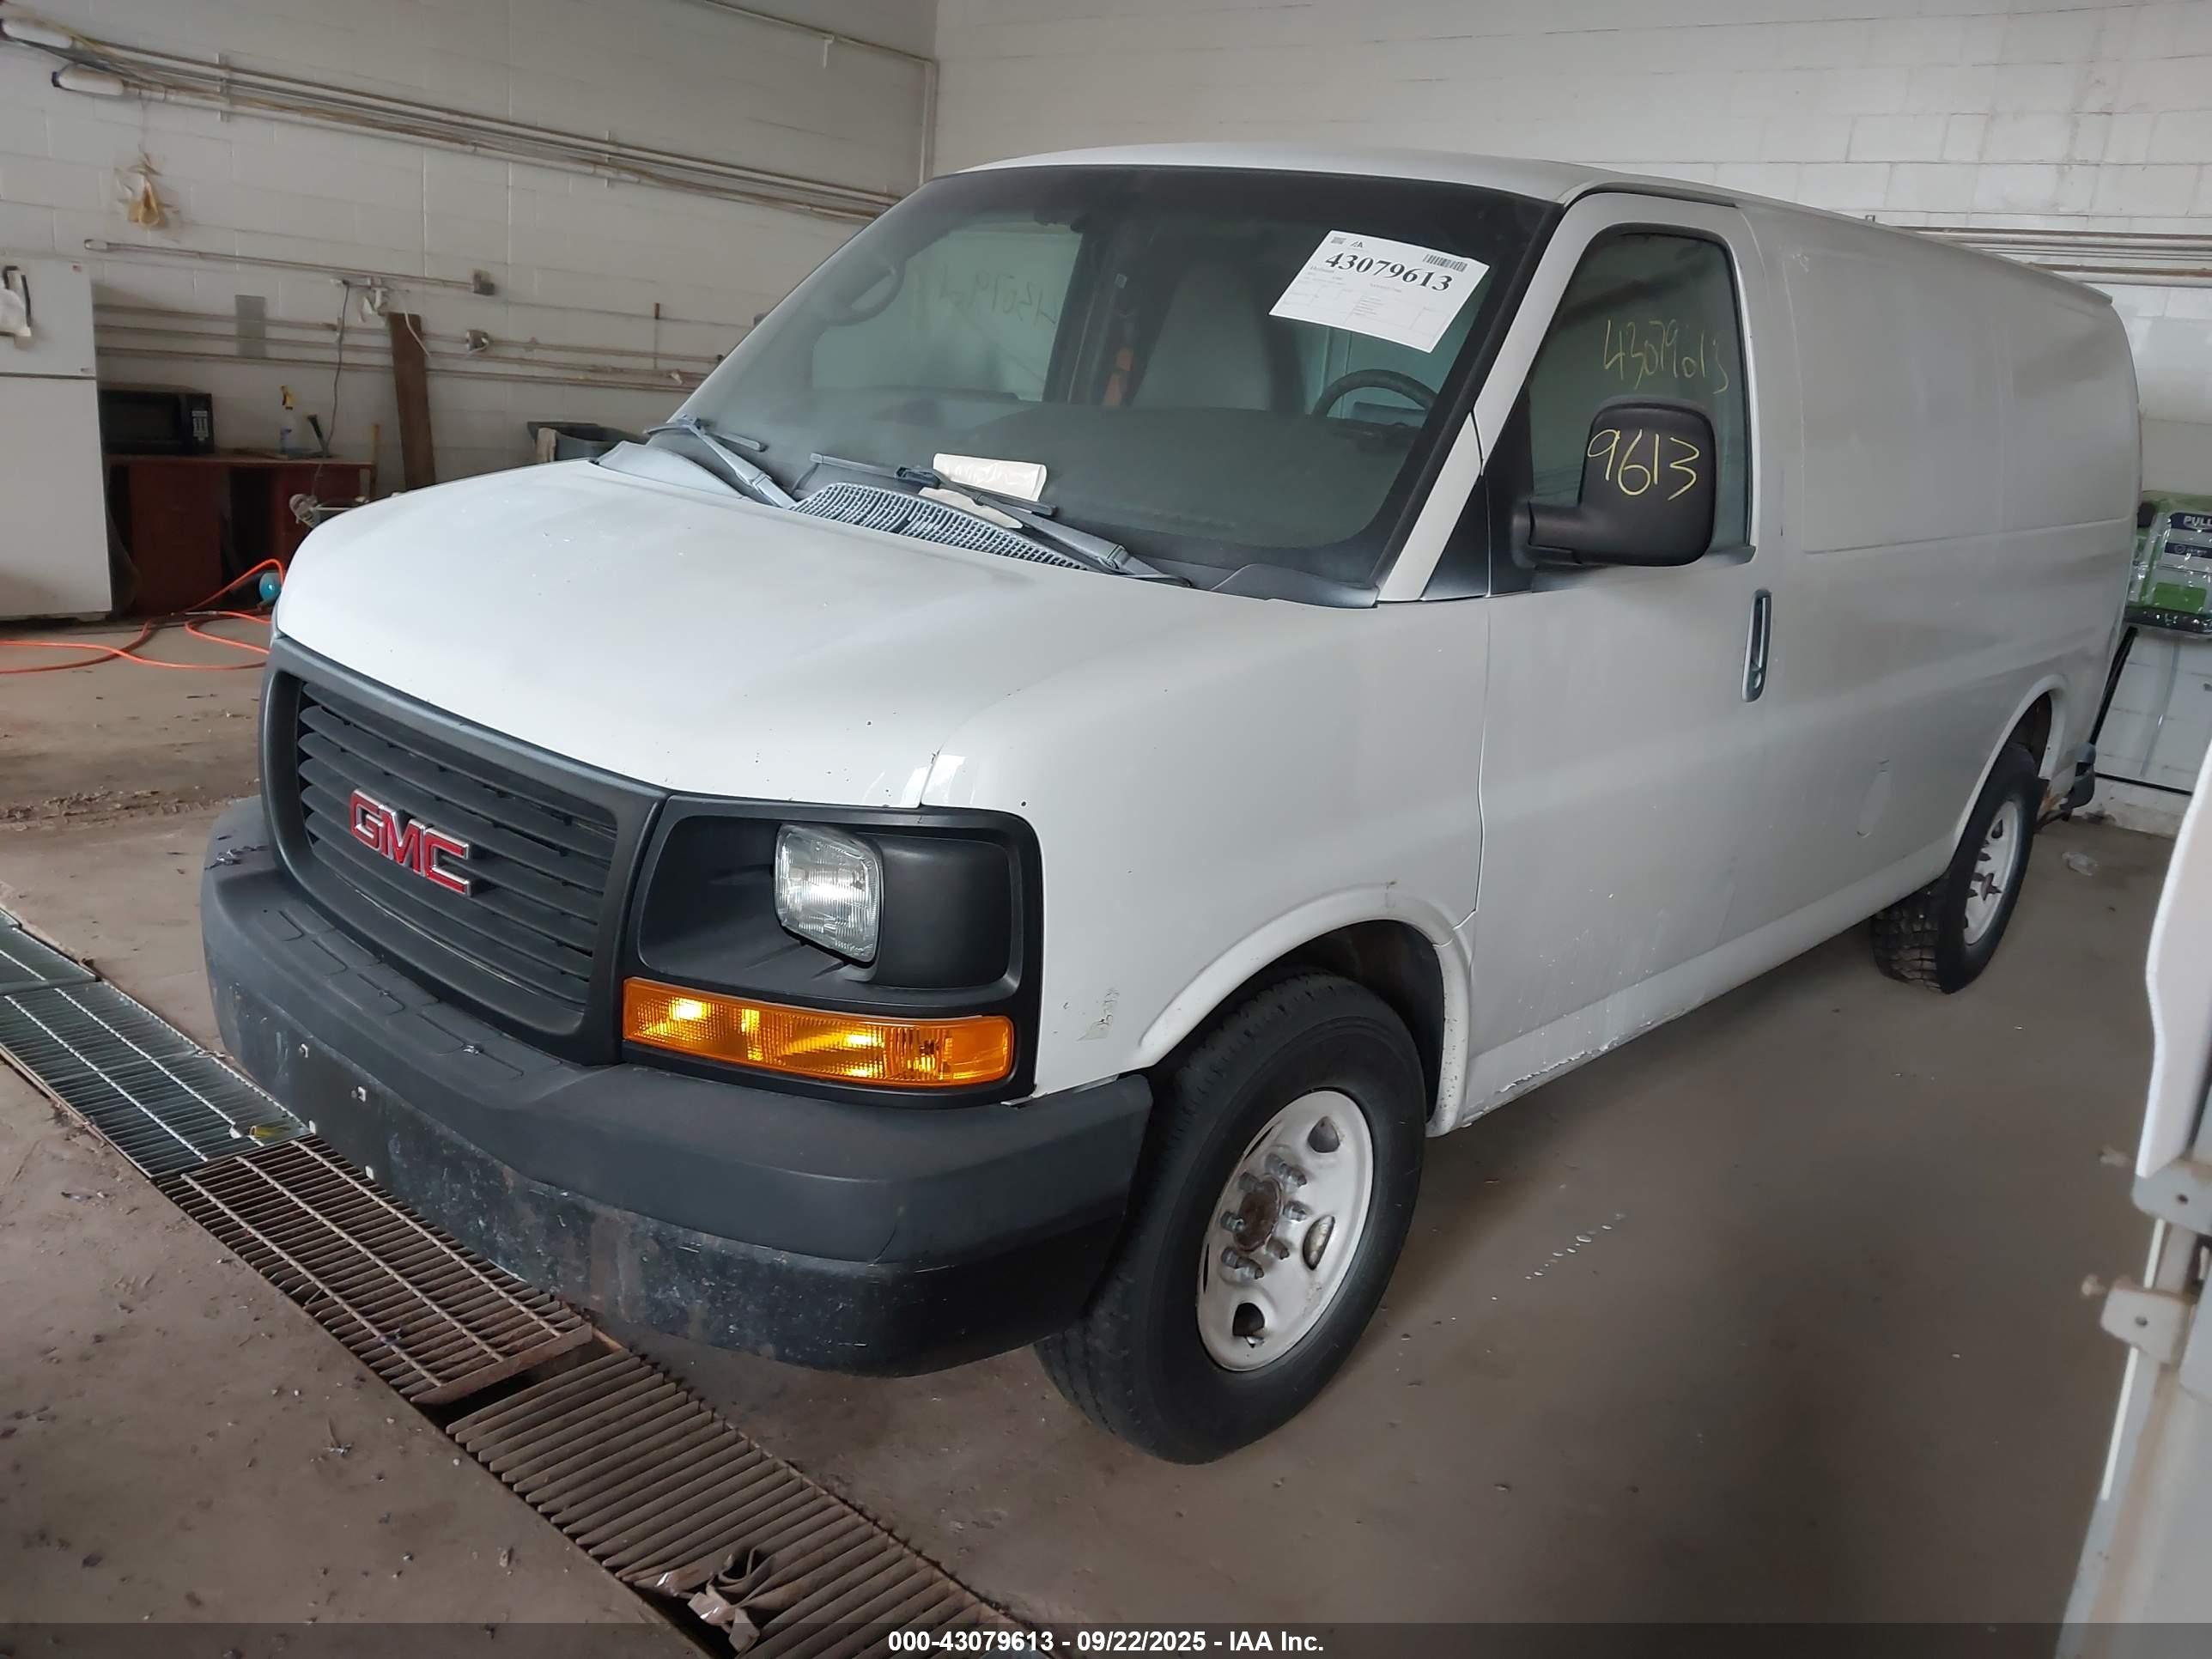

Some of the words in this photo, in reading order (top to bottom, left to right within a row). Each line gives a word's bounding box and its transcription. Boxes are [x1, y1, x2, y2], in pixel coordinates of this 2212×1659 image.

[1325, 252, 1453, 292] 43079613
[1587, 428, 1700, 501] 9613
[350, 788, 471, 896] GMC
